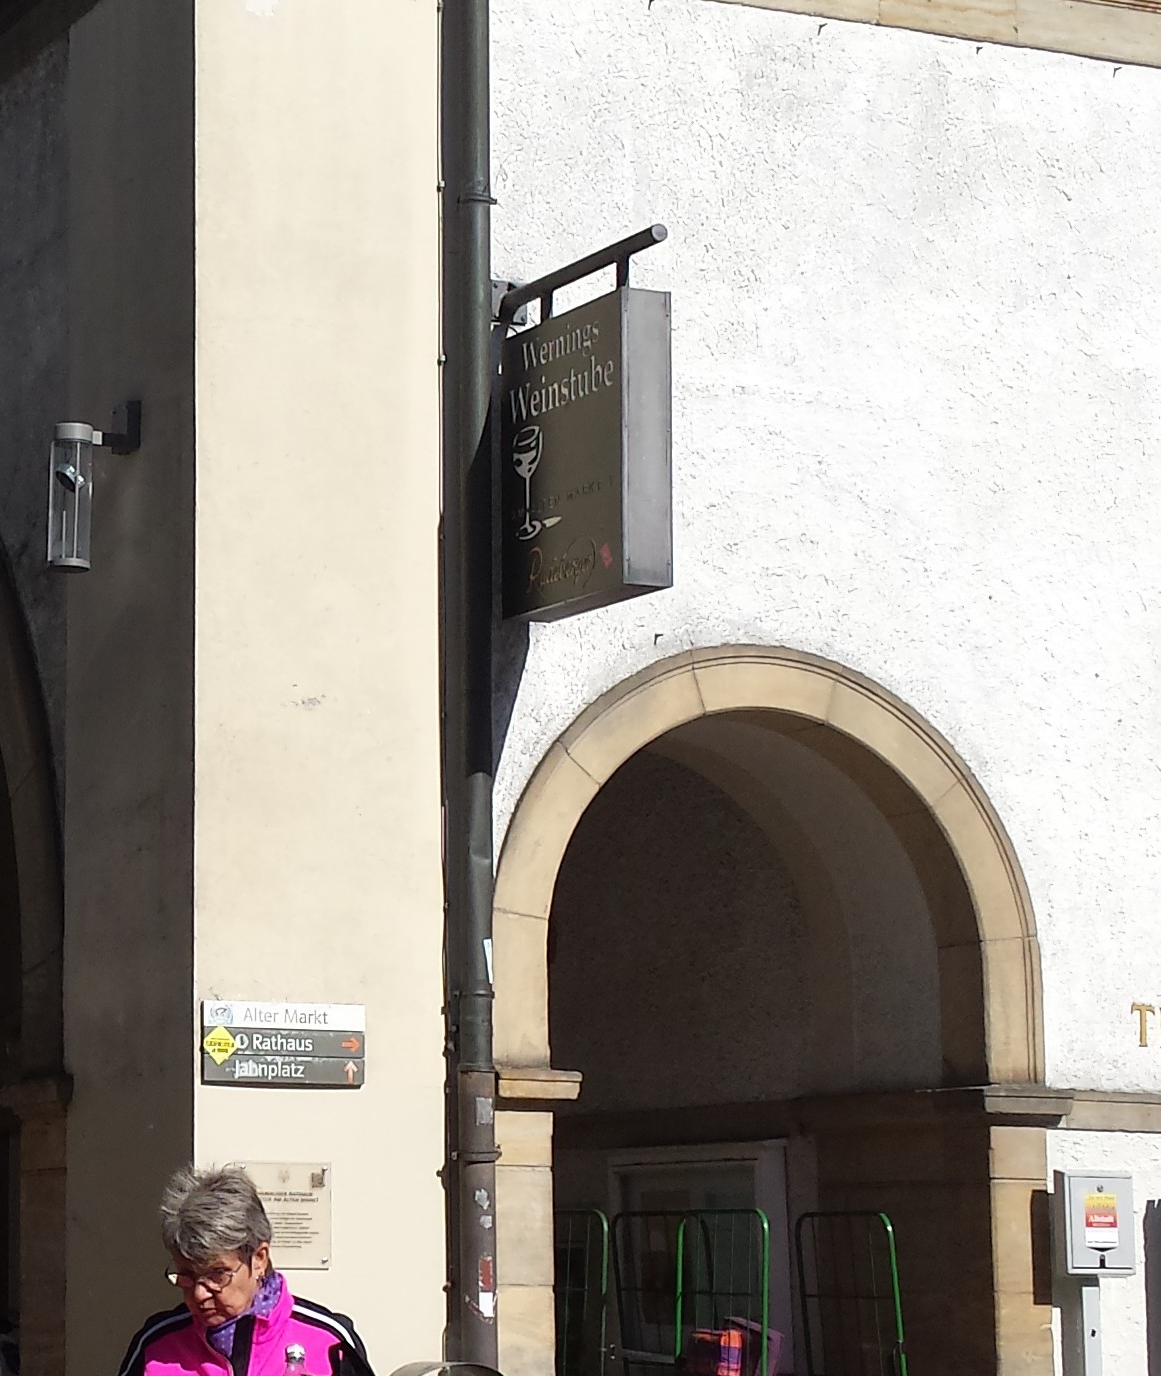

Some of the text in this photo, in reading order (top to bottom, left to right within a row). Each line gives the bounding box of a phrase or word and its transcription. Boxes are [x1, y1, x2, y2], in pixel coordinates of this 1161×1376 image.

[522, 320, 600, 371] Wernings
[509, 355, 615, 425] Weinstube
[243, 1007, 328, 1025] Alter Markt
[252, 1033, 314, 1052] Rathaus
